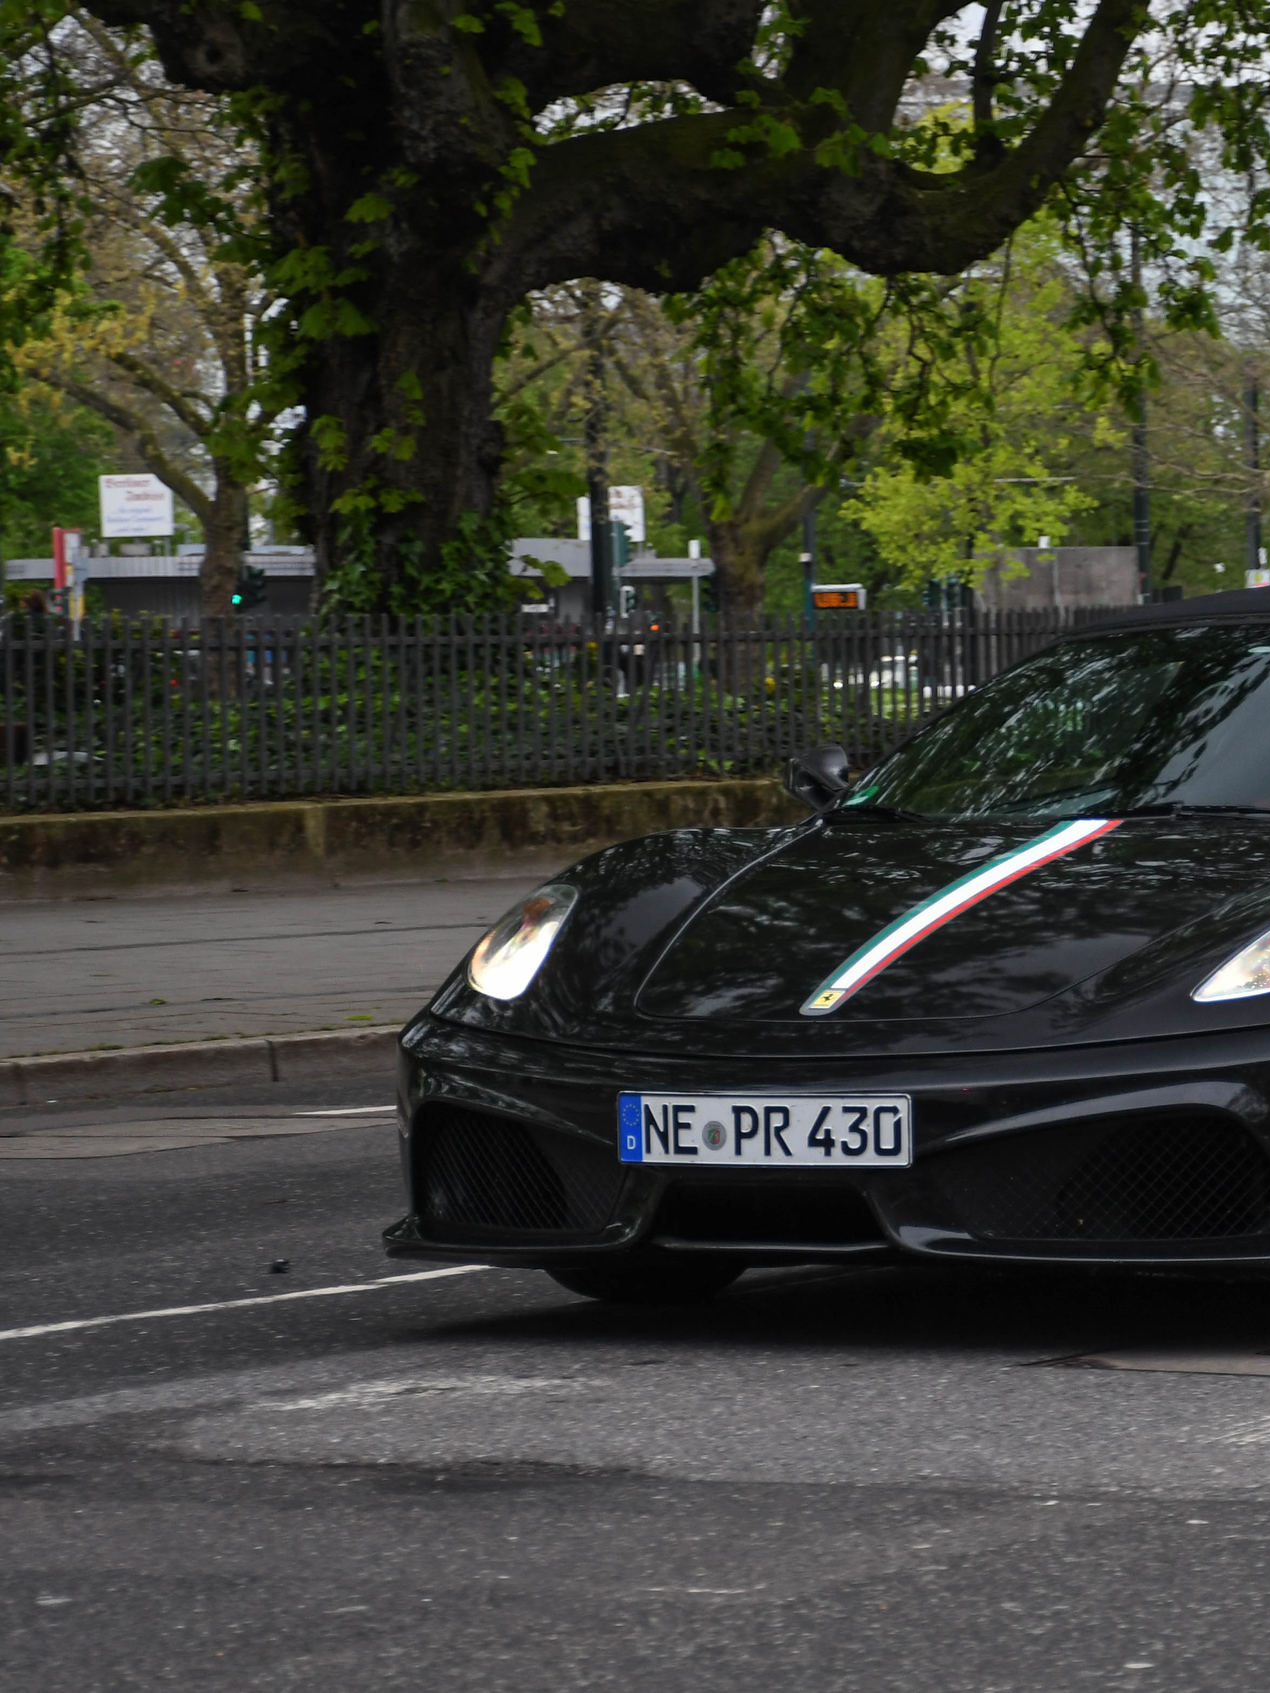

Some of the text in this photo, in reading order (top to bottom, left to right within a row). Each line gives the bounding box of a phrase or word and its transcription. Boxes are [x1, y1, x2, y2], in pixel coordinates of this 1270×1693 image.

[627, 1135, 636, 1150] D
[643, 1103, 902, 1157] NE PR 430
